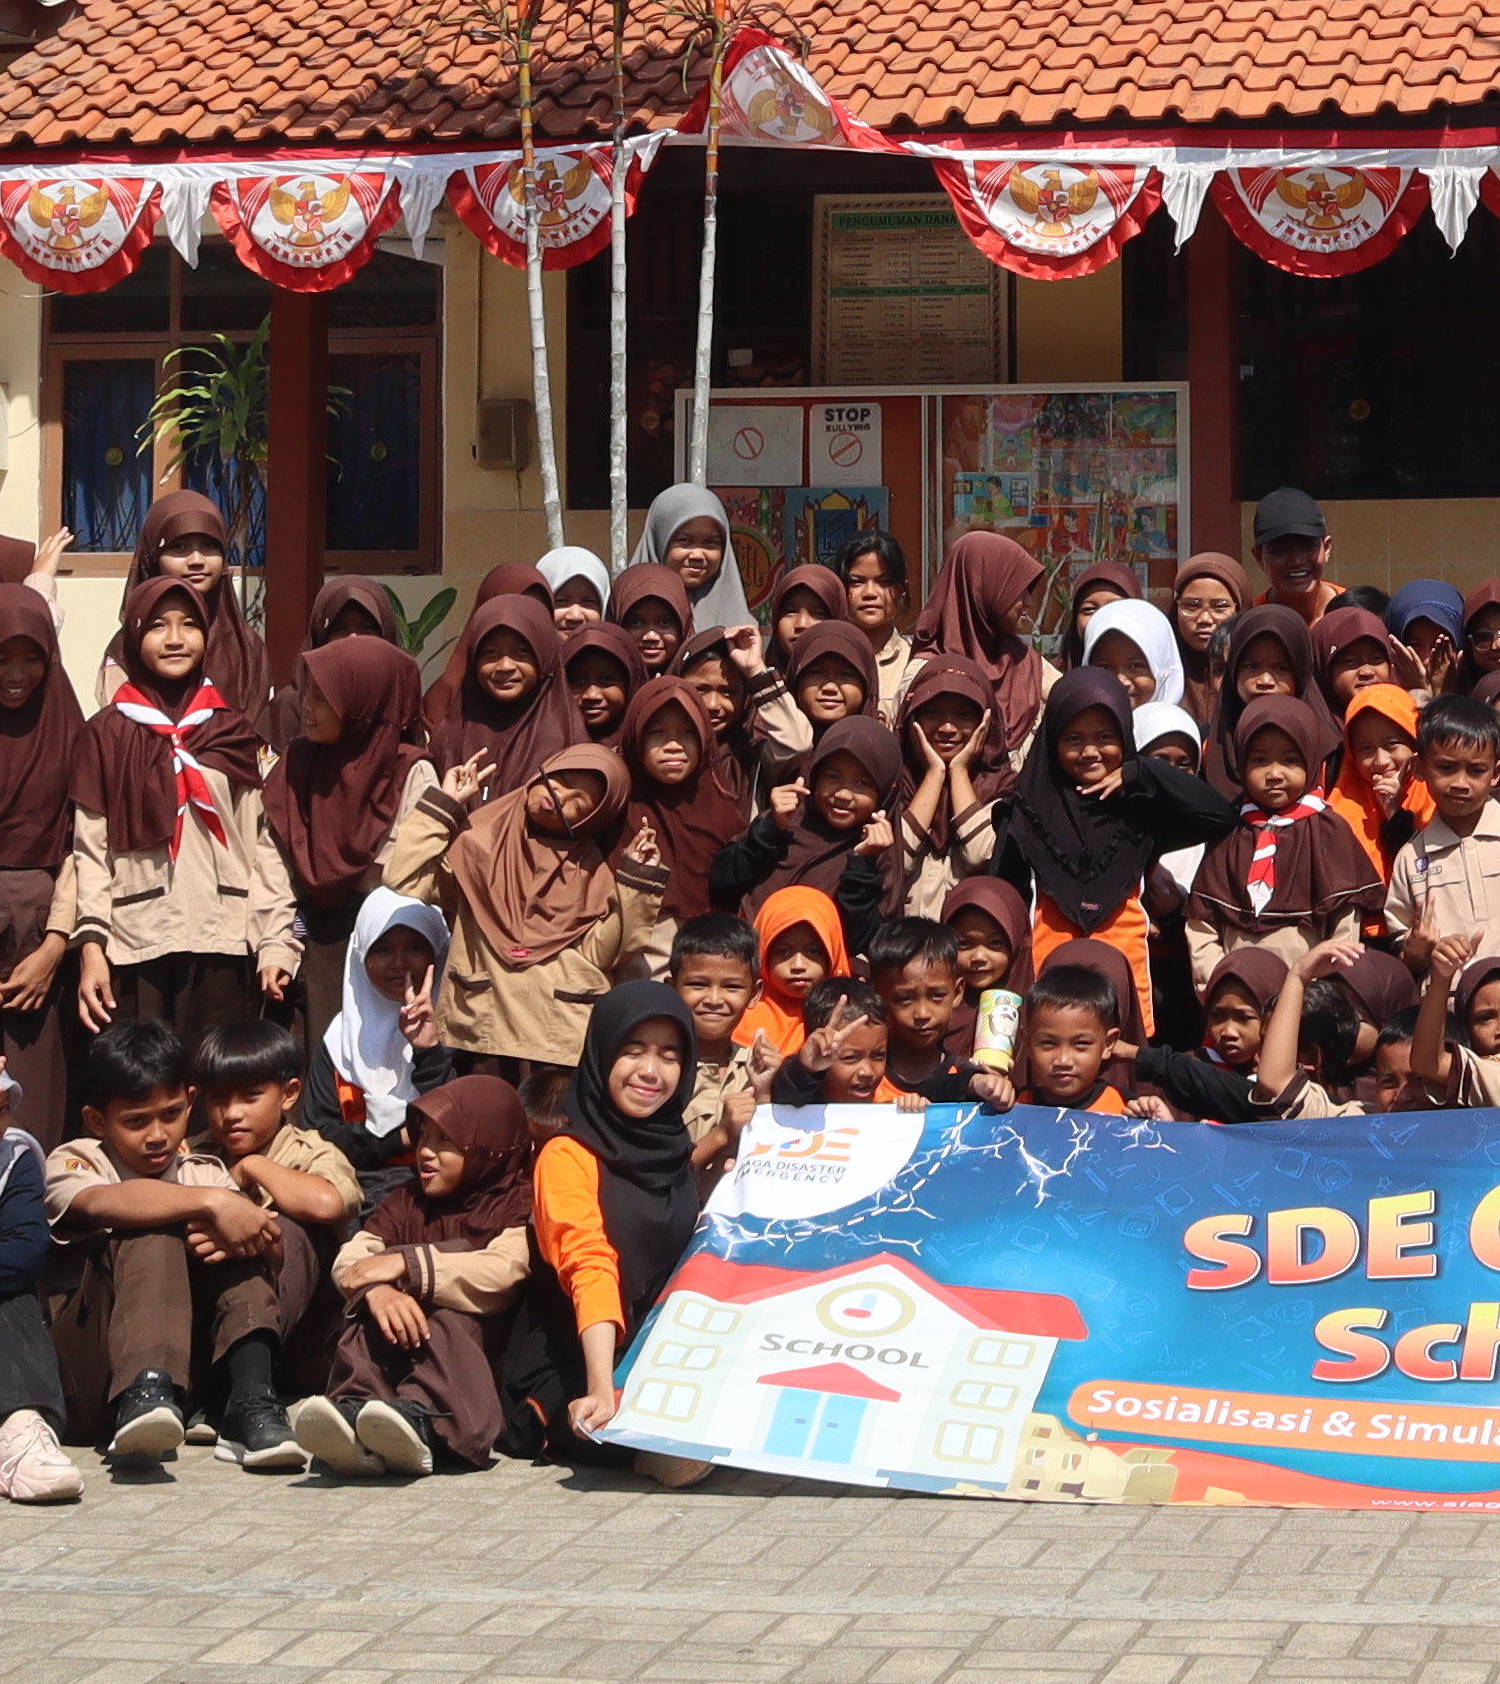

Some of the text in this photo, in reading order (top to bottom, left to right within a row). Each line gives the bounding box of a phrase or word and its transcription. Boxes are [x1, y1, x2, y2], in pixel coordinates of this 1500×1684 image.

[824, 408, 871, 422] STOP
[776, 1161, 846, 1175] DISASTER
[1182, 1189, 1437, 1290] SDE
[759, 1333, 930, 1369] SCHOOL
[1086, 1389, 1312, 1433] Sosialisasi
[1322, 1411, 1357, 1439] &
